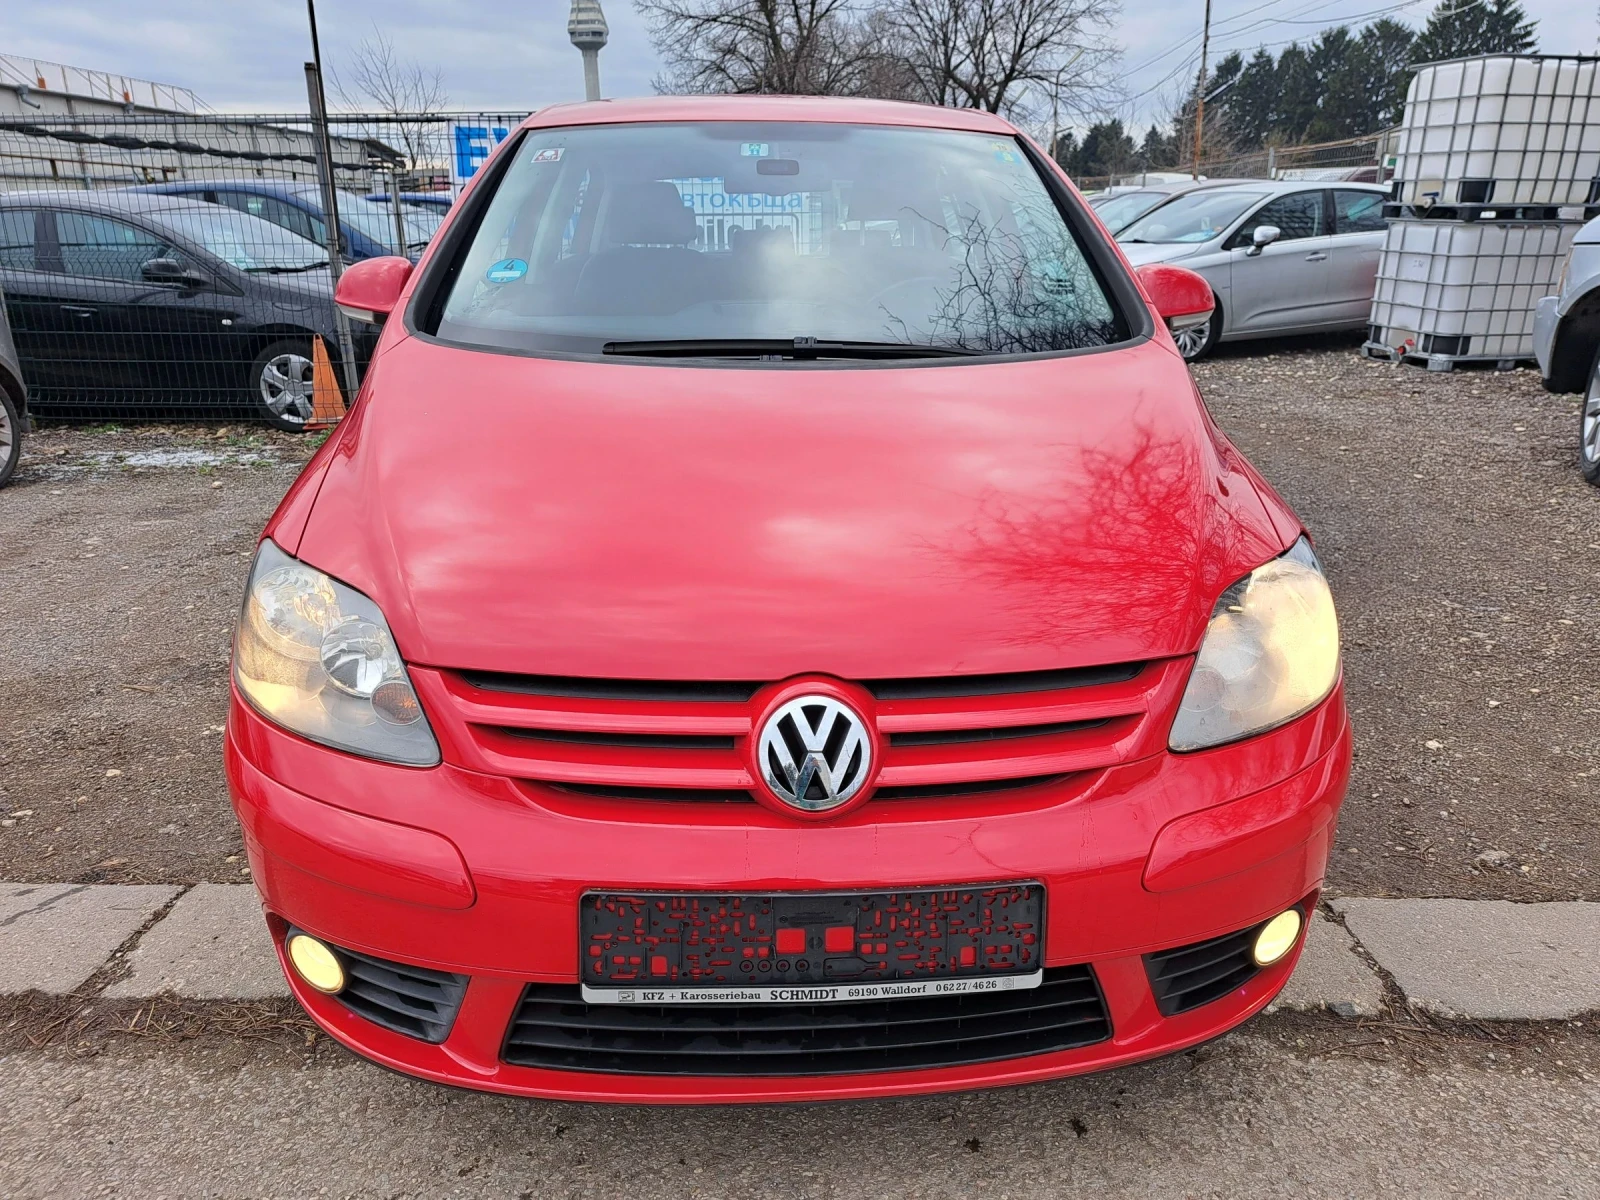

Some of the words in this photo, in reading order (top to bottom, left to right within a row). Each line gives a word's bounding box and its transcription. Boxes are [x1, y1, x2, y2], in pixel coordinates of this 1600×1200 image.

[682, 193, 801, 211] втокъща
[503, 259, 515, 271] 4
[642, 991, 665, 1001] KFZ
[668, 992, 677, 1000] +
[680, 990, 761, 1001] Karosseriebau
[770, 988, 839, 1001] SCHMIDT
[848, 987, 878, 998] 69190
[881, 984, 928, 996] Walldorf
[935, 980, 998, 993] 06227/4626
